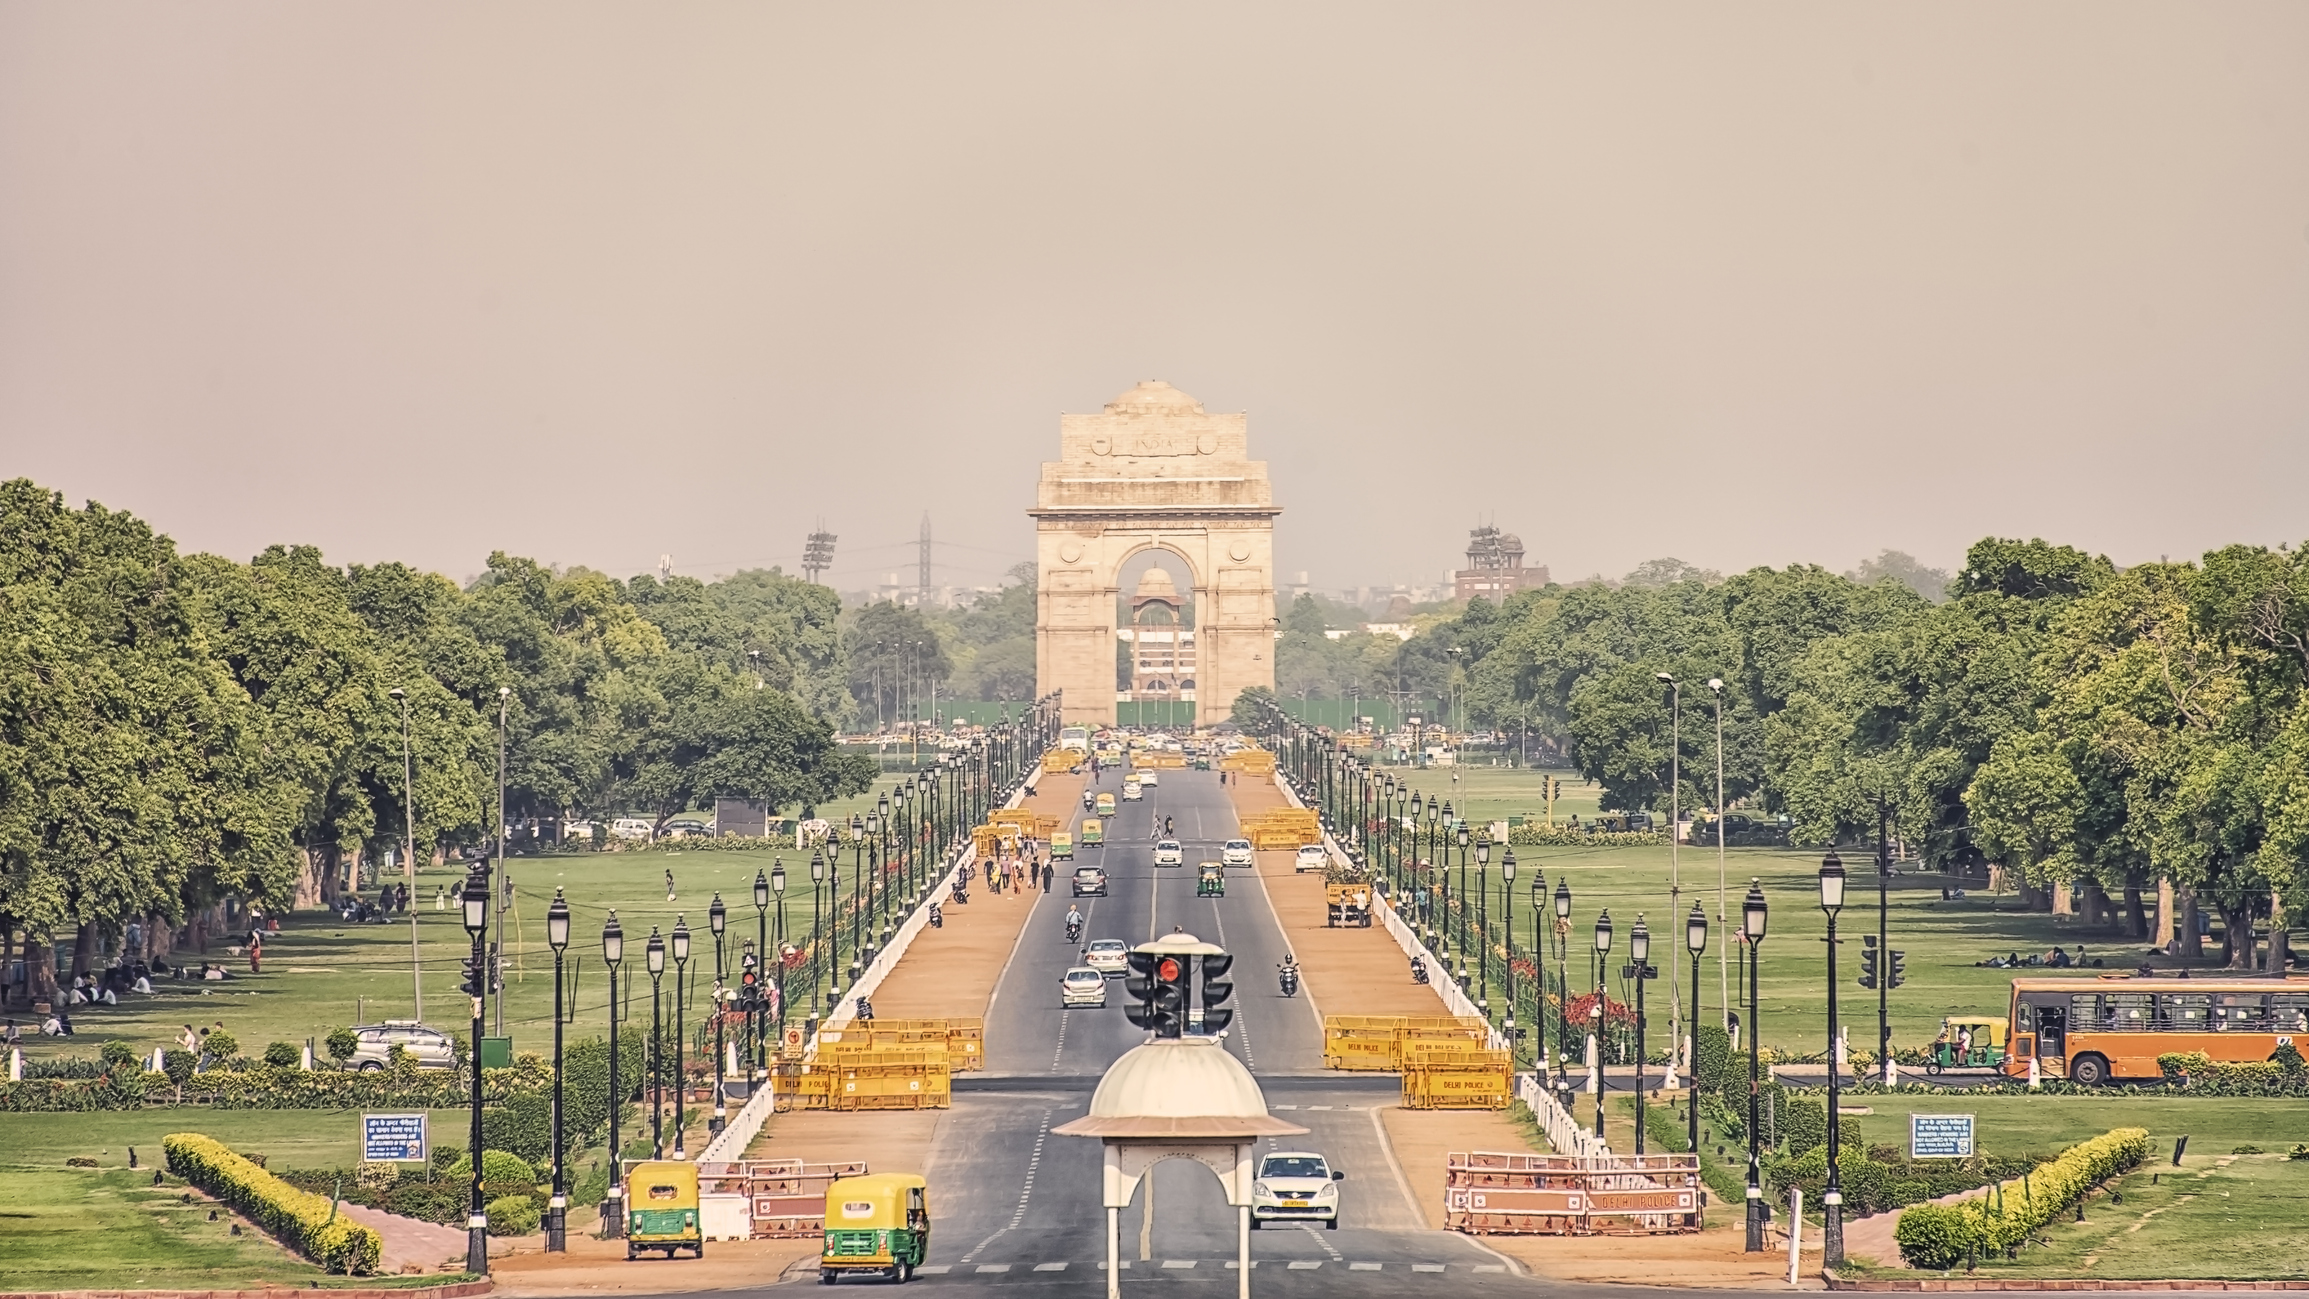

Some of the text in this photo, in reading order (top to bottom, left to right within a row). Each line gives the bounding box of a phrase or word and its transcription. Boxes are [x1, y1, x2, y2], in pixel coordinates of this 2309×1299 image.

[1135, 439, 1173, 449] INDIA
[949, 1044, 965, 1052] OLICE
[1363, 1044, 1379, 1052] POLICE
[1443, 1081, 1484, 1089] DELHI POLICE
[1602, 1194, 1676, 1209] DELHI POLICE
